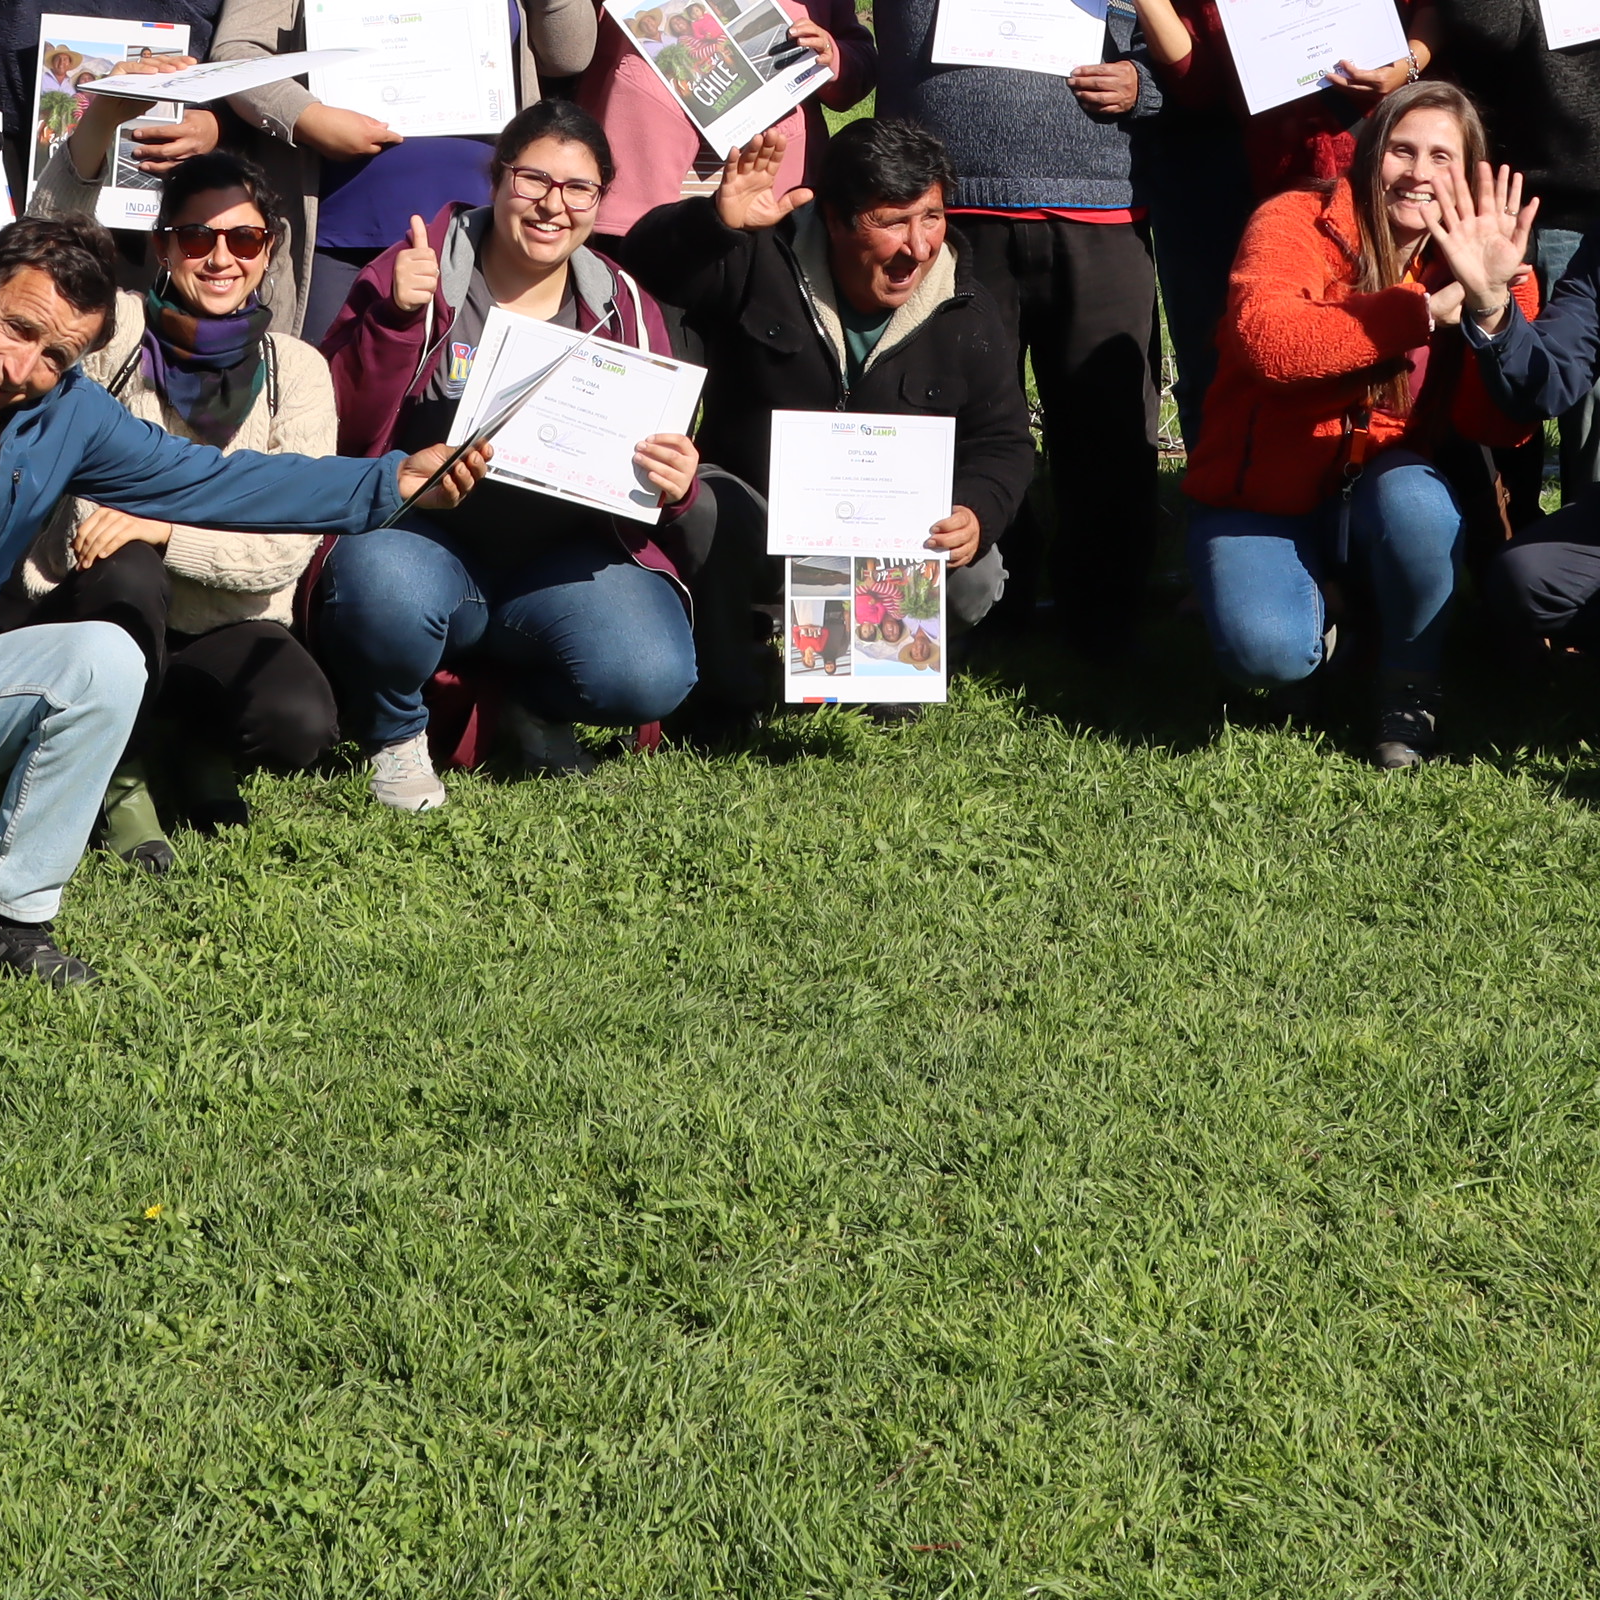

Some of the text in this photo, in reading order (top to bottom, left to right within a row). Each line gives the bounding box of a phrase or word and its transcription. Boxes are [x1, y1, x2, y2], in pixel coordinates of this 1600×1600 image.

[693, 60, 739, 107] CHILE
[711, 77, 747, 112] RURAL
[488, 89, 498, 122] INDAP
[125, 202, 159, 213] INDAP
[572, 376, 600, 390] DIPLOMA
